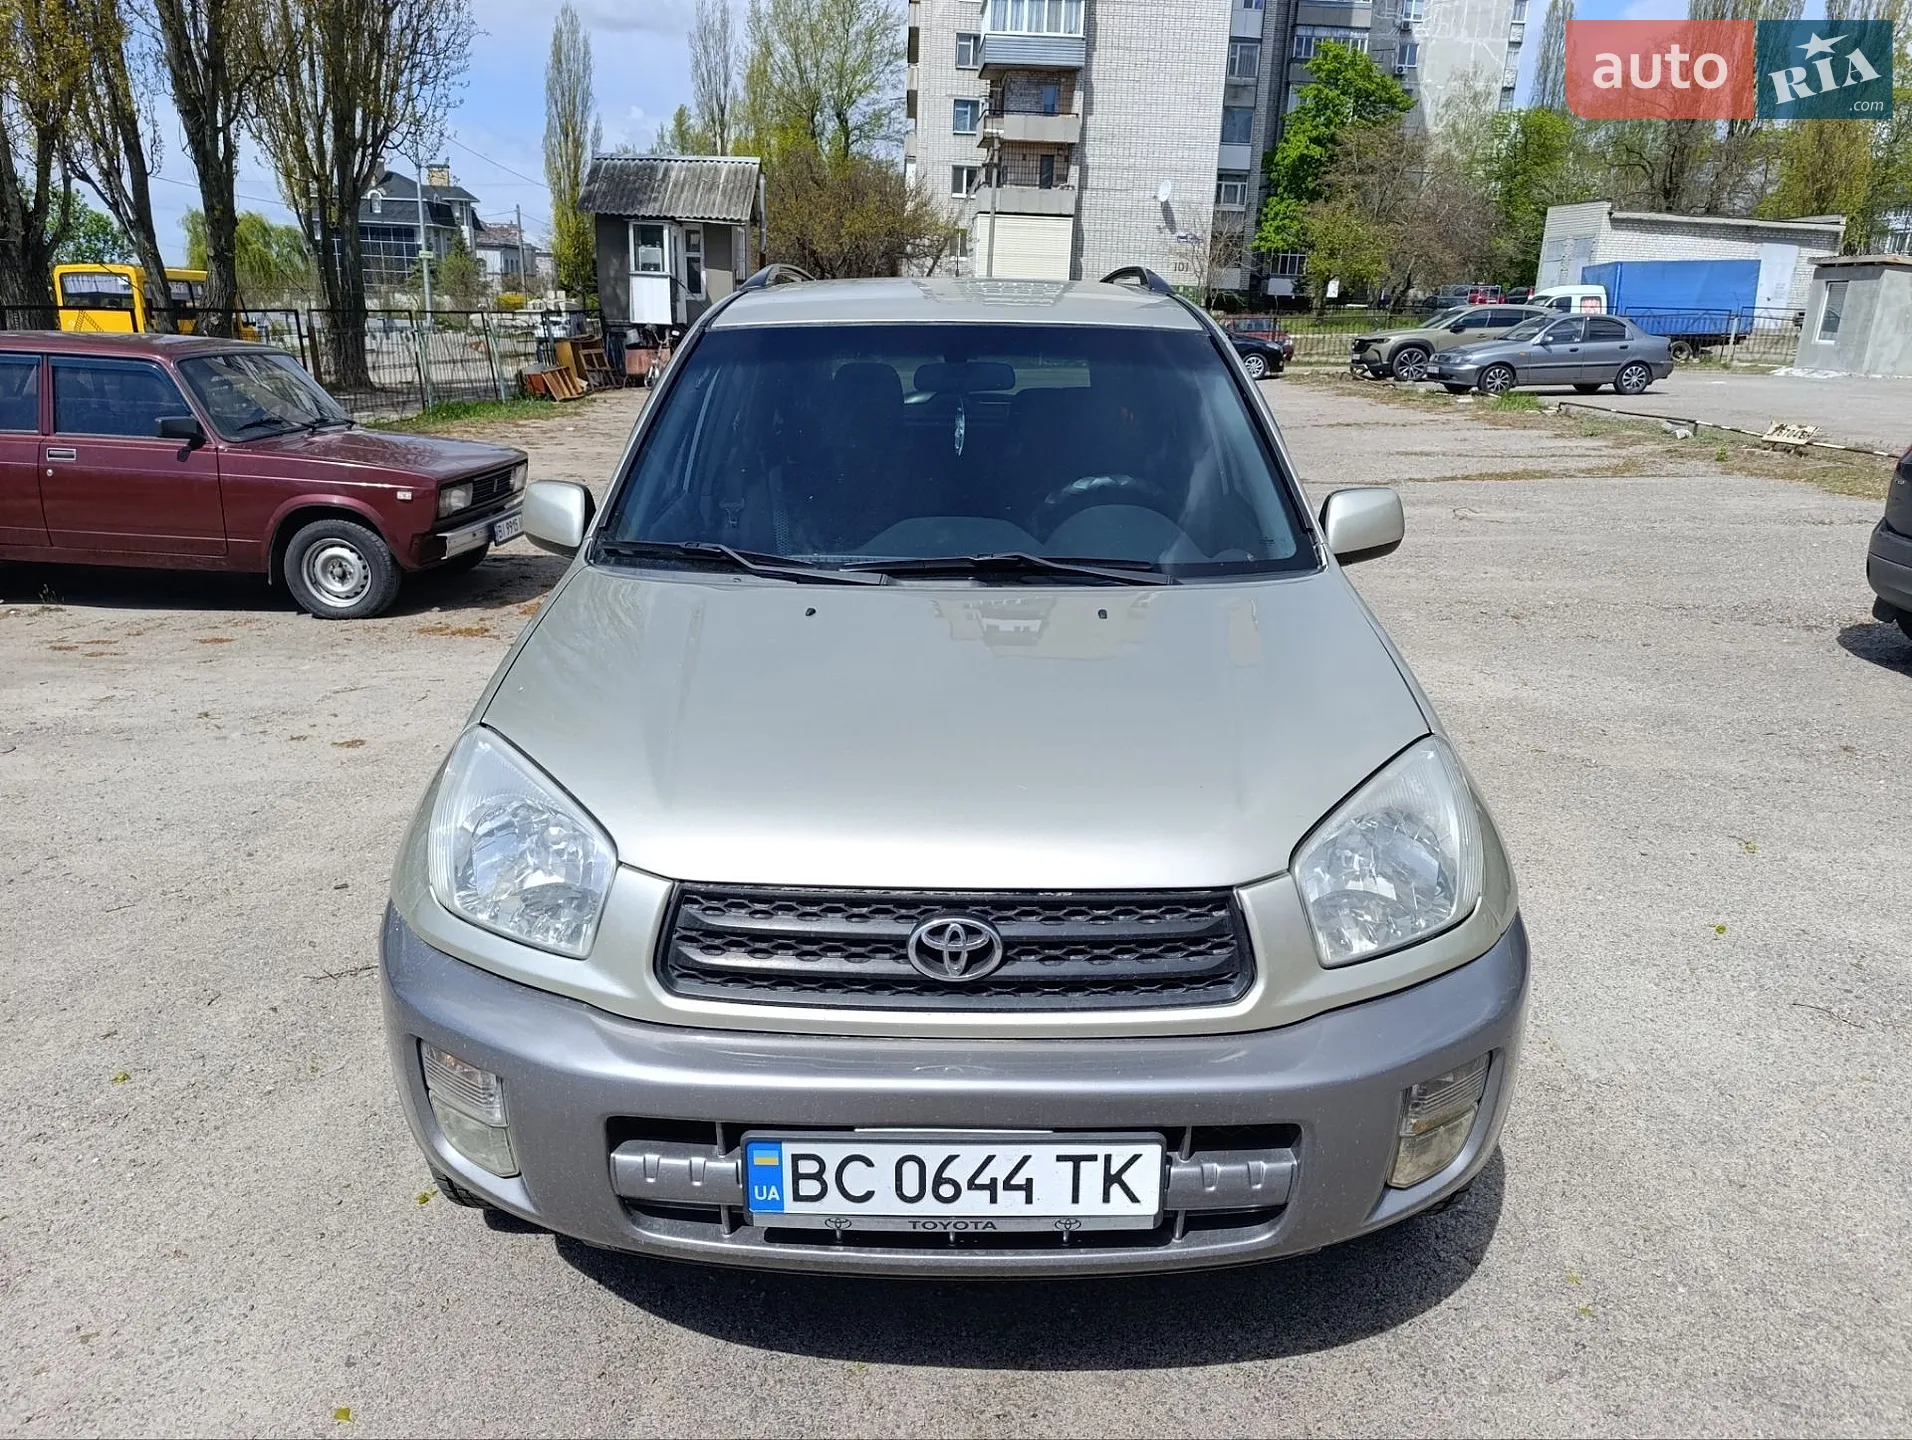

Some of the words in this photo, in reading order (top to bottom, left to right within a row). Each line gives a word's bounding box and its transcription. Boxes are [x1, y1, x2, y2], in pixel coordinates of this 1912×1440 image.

[790, 1153, 876, 1204] BC
[894, 1154, 1034, 1205] 0644
[1055, 1153, 1143, 1204] TK
[754, 1186, 780, 1201] UA
[908, 1220, 997, 1231] TOYOTA
